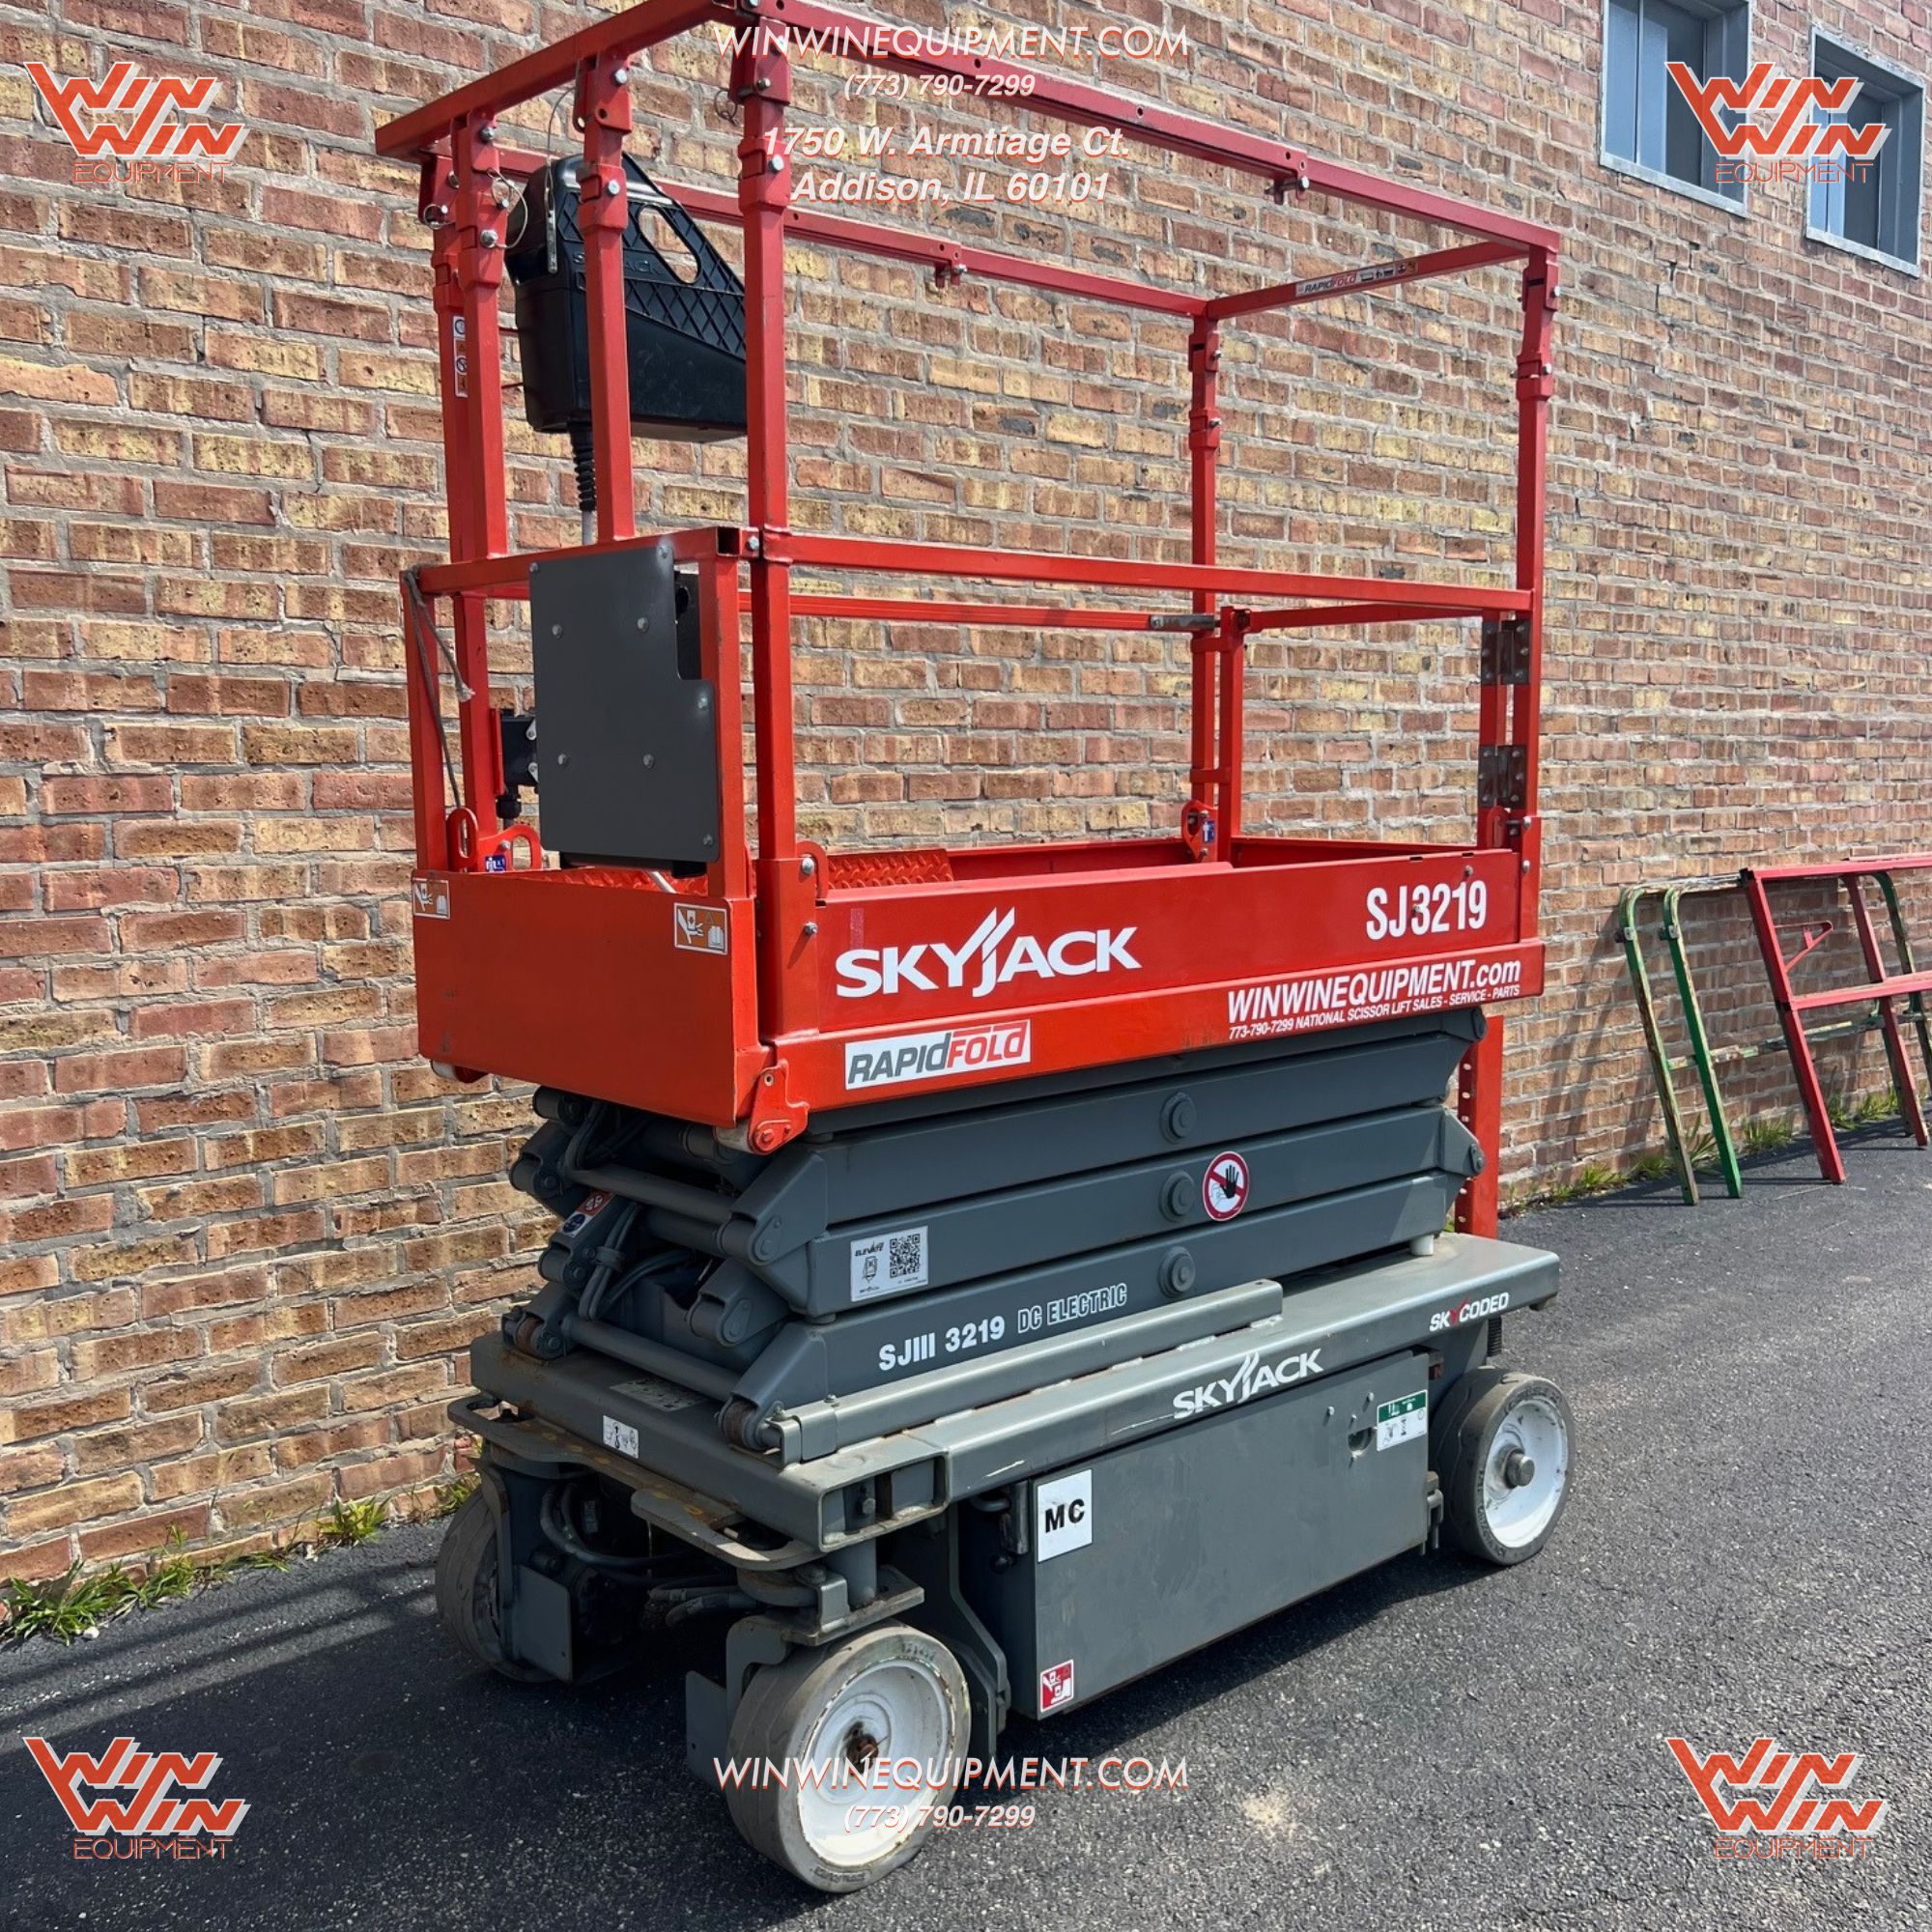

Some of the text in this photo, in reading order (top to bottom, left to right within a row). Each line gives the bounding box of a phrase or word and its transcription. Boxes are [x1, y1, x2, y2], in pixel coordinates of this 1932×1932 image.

[1366, 880, 1487, 941] SJ3219
[835, 906, 1143, 998] SKYJACK
[1227, 958, 1521, 1024] WINWINEQUIPMENT.com
[1229, 1020, 1293, 1040] 773-790-7299
[1295, 1009, 1346, 1030] NATIONAL
[1348, 1000, 1390, 1022] SCISSOR
[1391, 999, 1412, 1015] LIFT
[1411, 995, 1443, 1012] SALES
[1449, 988, 1488, 1007] SERVICE
[1492, 983, 1520, 1000] PARTS
[944, 1315, 1006, 1352] 3219
[1017, 1283, 1128, 1334] DC ELECTRIC
[1173, 1348, 1324, 1420] SKYJACK
[1044, 1499, 1086, 1534] MC
